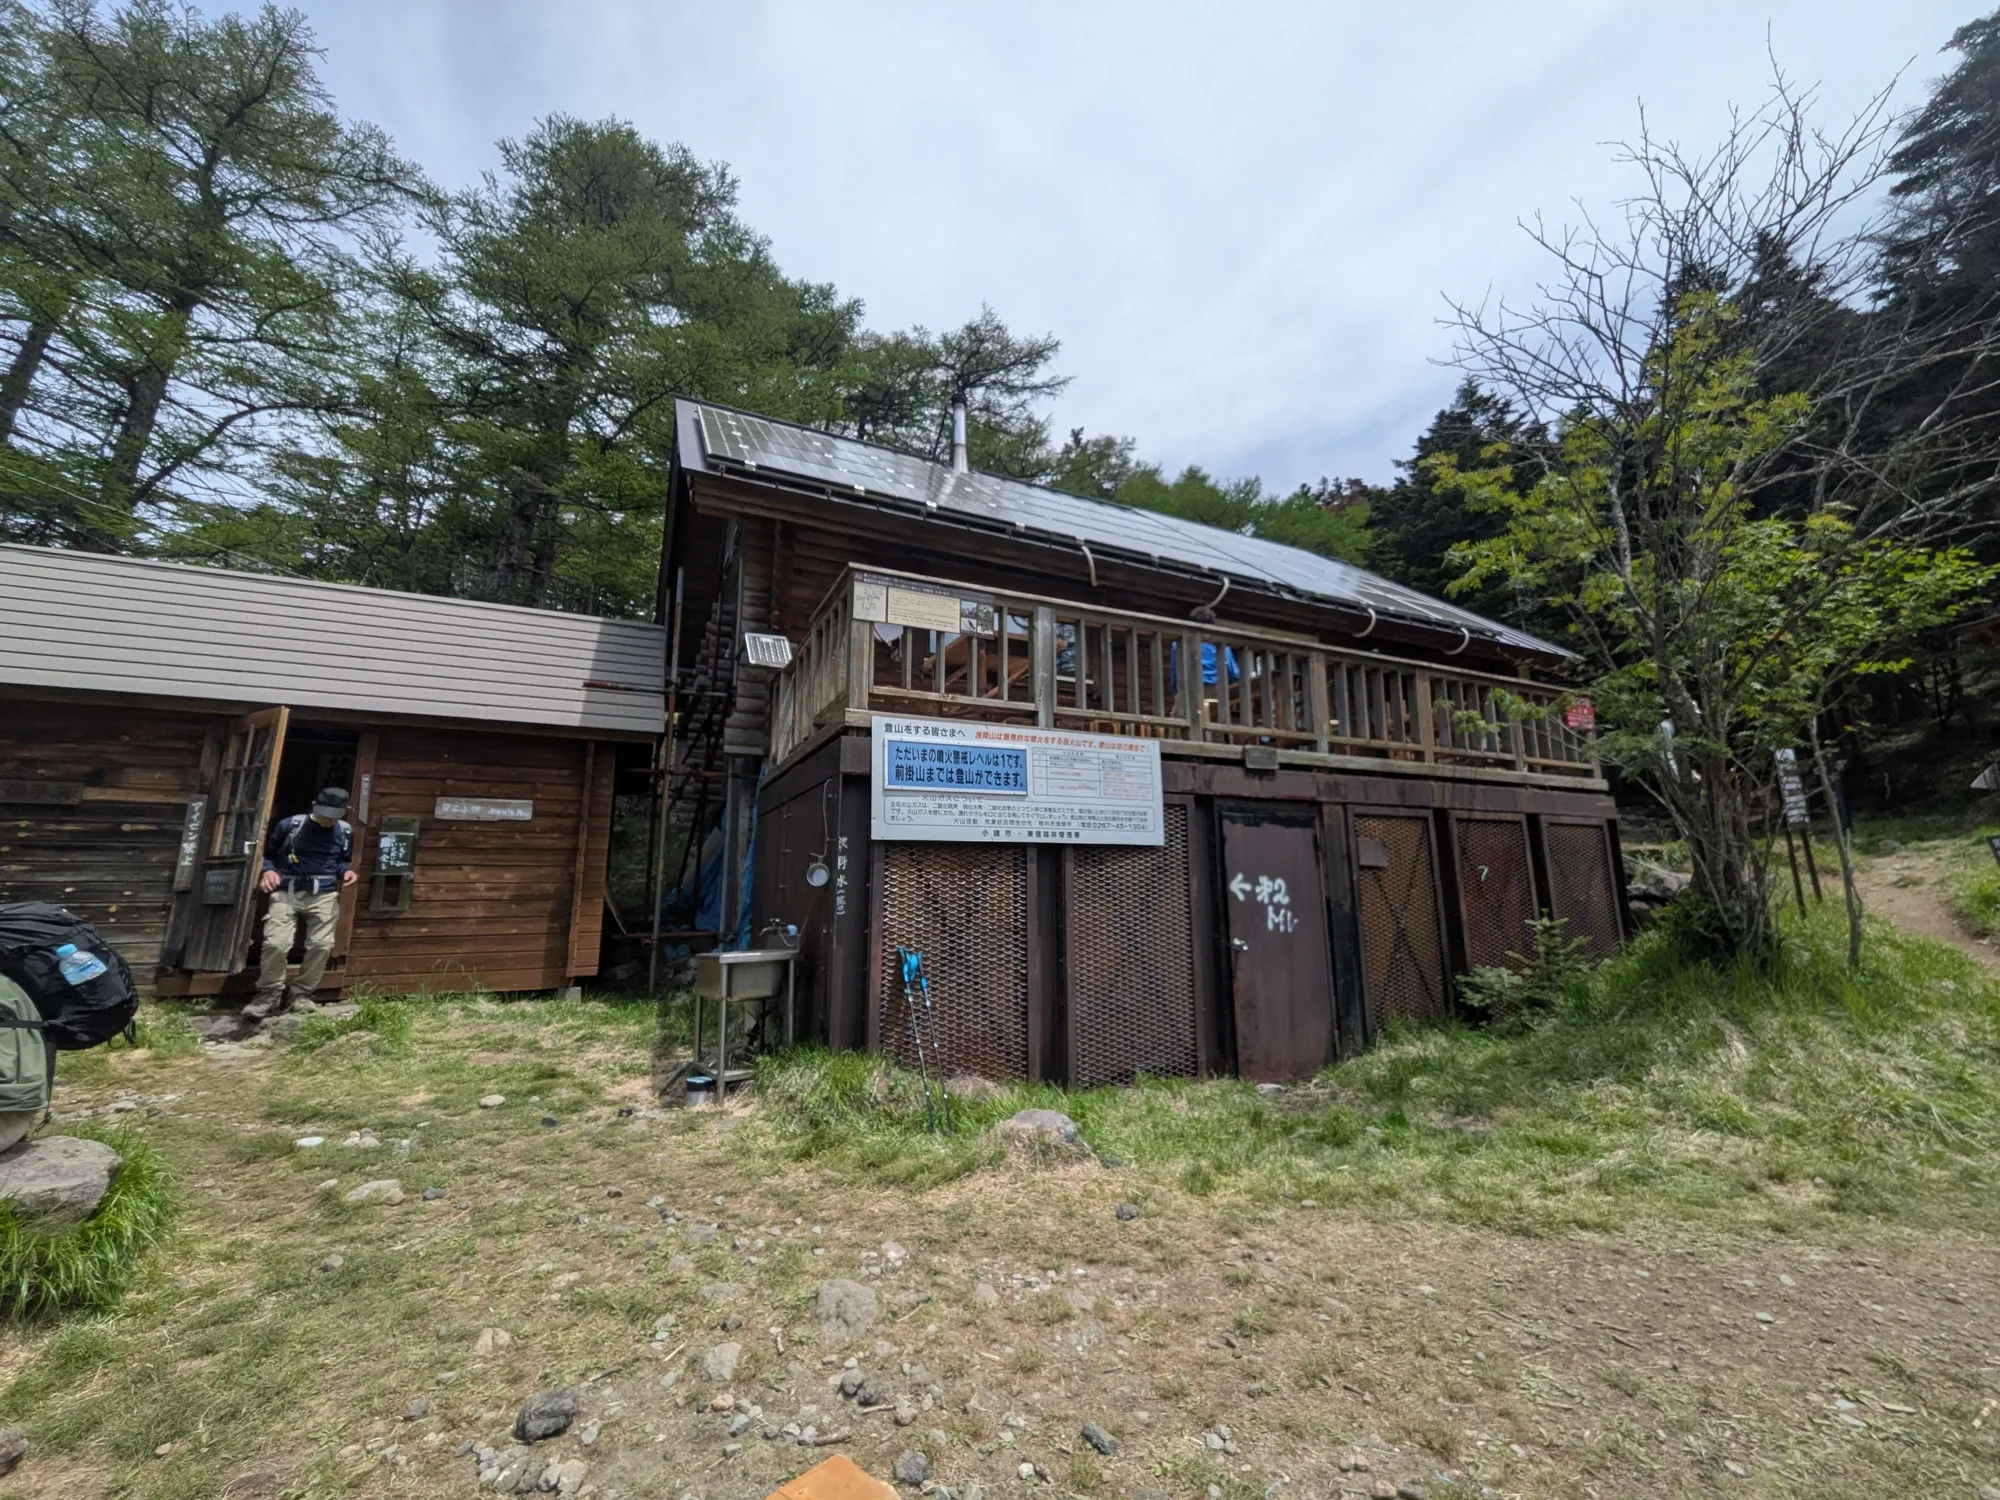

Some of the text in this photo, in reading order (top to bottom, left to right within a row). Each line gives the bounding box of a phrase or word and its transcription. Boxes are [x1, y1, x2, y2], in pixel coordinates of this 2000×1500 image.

[884, 722, 966, 738] 登山をする皆さまへ
[895, 746, 1023, 769] ただいまの噴火警戒レベルは1です。
[895, 764, 1024, 788] 前掛山までは登山ができます。
[921, 793, 984, 804] 火山ガスについて
